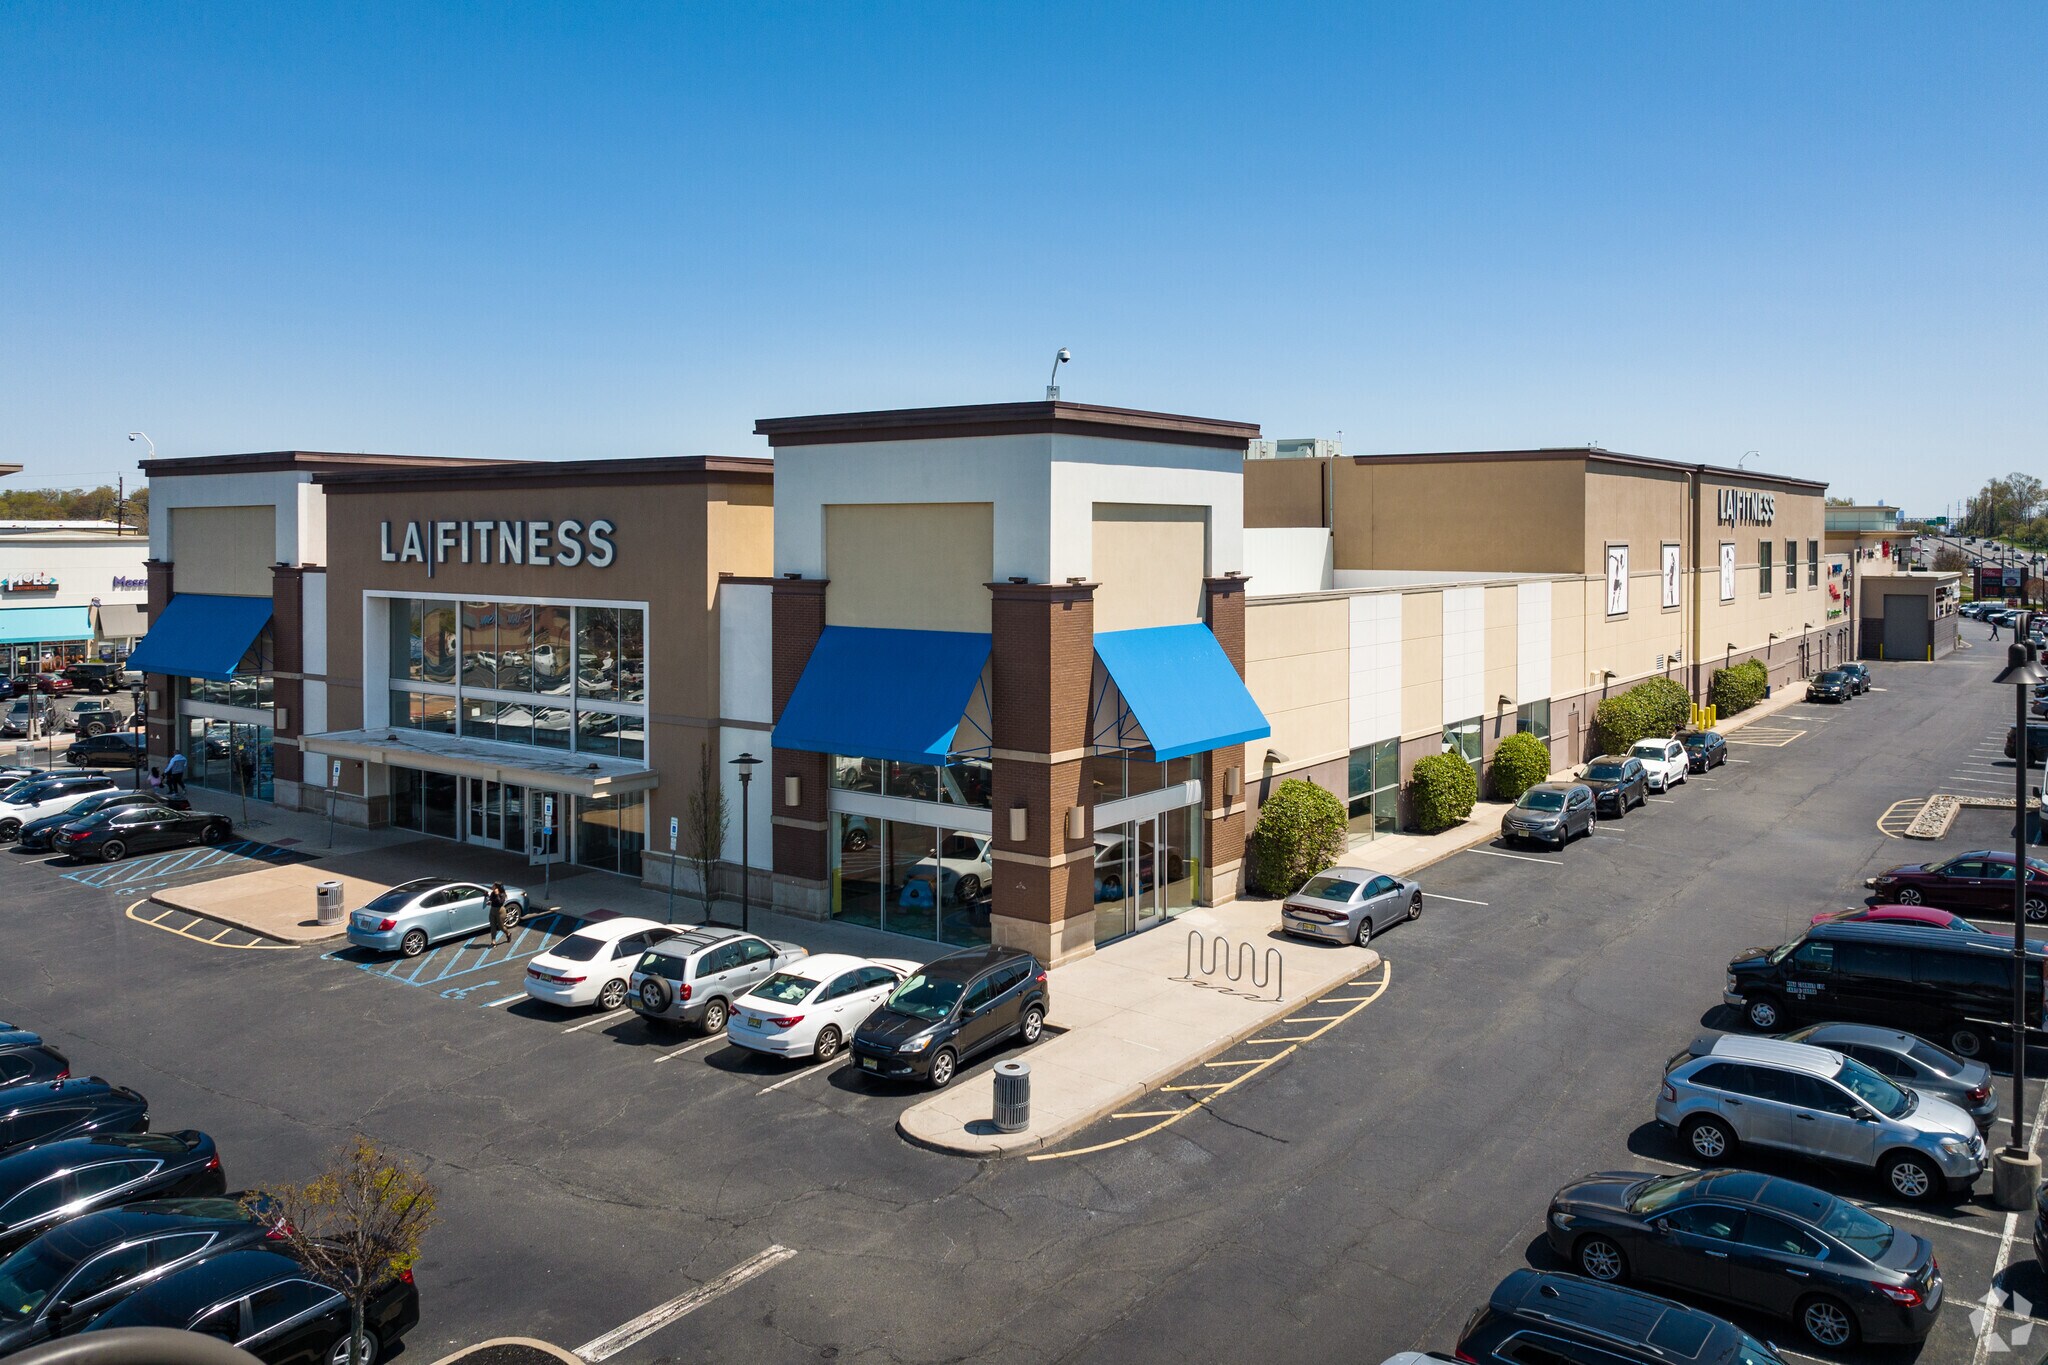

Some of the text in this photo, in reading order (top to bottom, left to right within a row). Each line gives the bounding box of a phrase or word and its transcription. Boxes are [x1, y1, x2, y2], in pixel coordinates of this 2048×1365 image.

[1736, 491, 1776, 521] FITNESS
[380, 519, 616, 568] LA FITNESS
